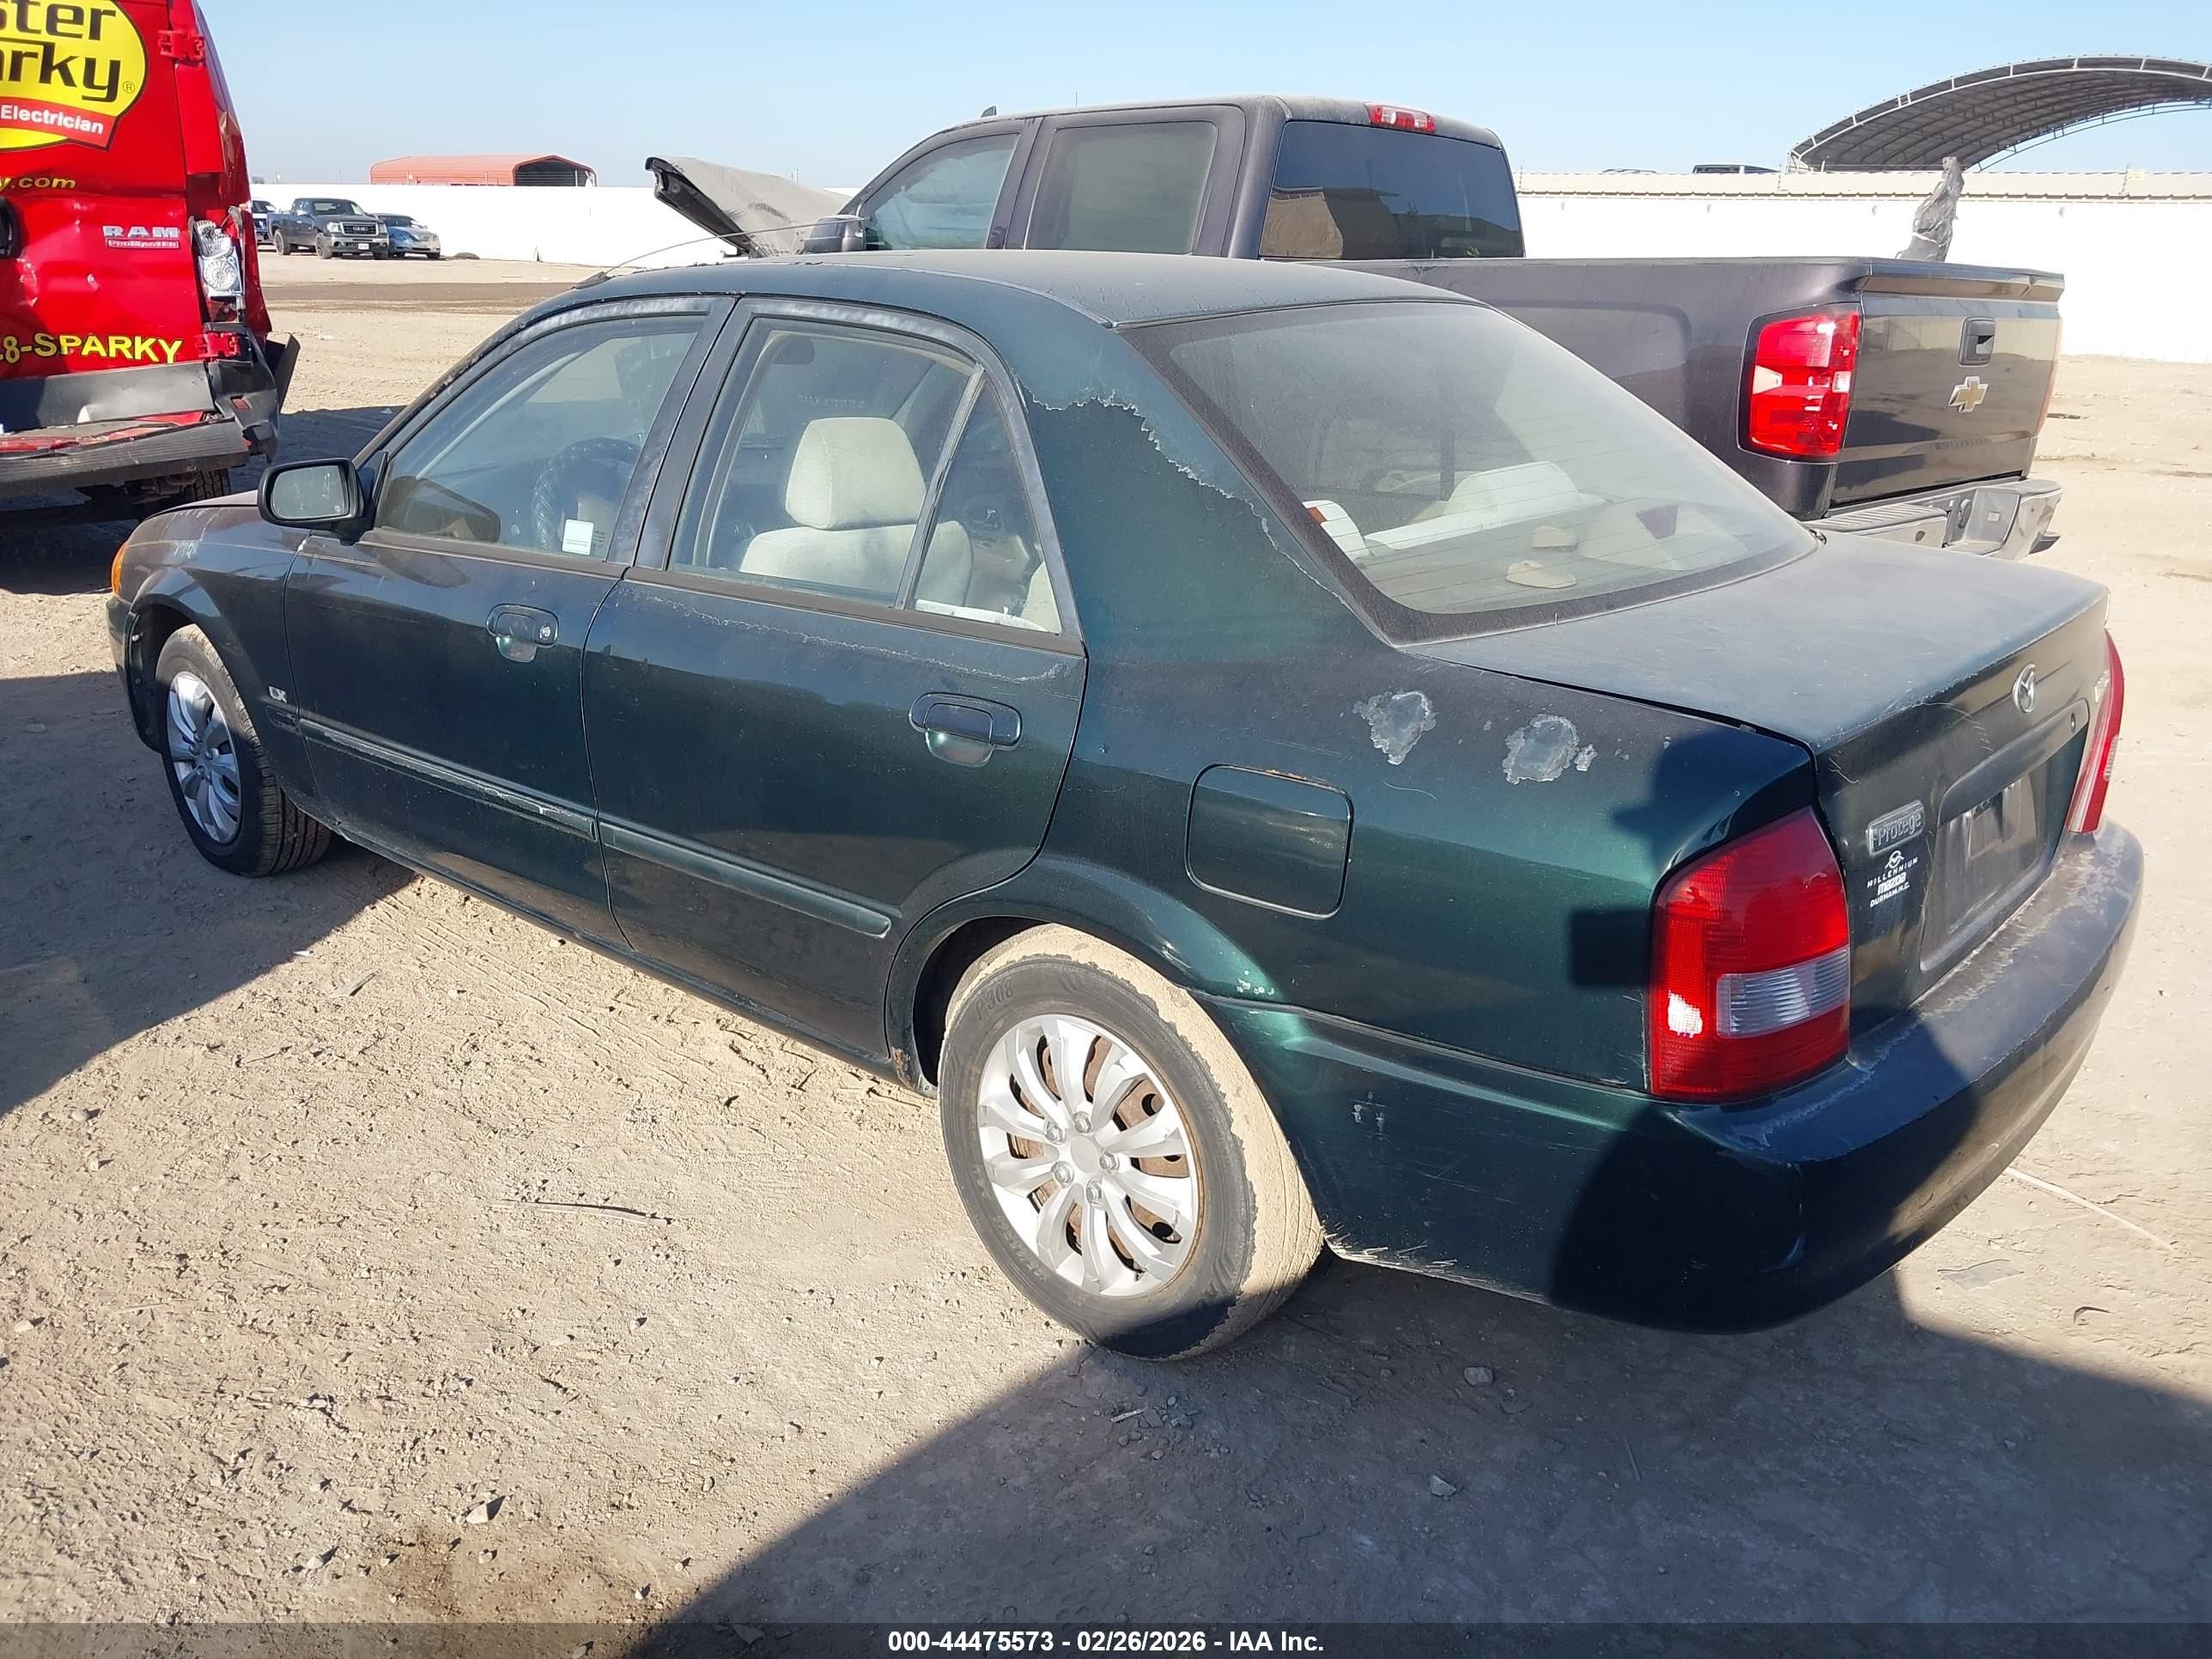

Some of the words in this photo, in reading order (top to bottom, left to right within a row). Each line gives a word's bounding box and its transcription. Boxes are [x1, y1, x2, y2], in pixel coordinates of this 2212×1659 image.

[0, 0, 116, 41] ter
[0, 42, 121, 102] rky
[0, 104, 104, 135] Electrician
[102, 225, 179, 238] RAM
[0, 333, 183, 364] 8-SPARKY
[1867, 856, 1918, 889] MILLENNIUM
